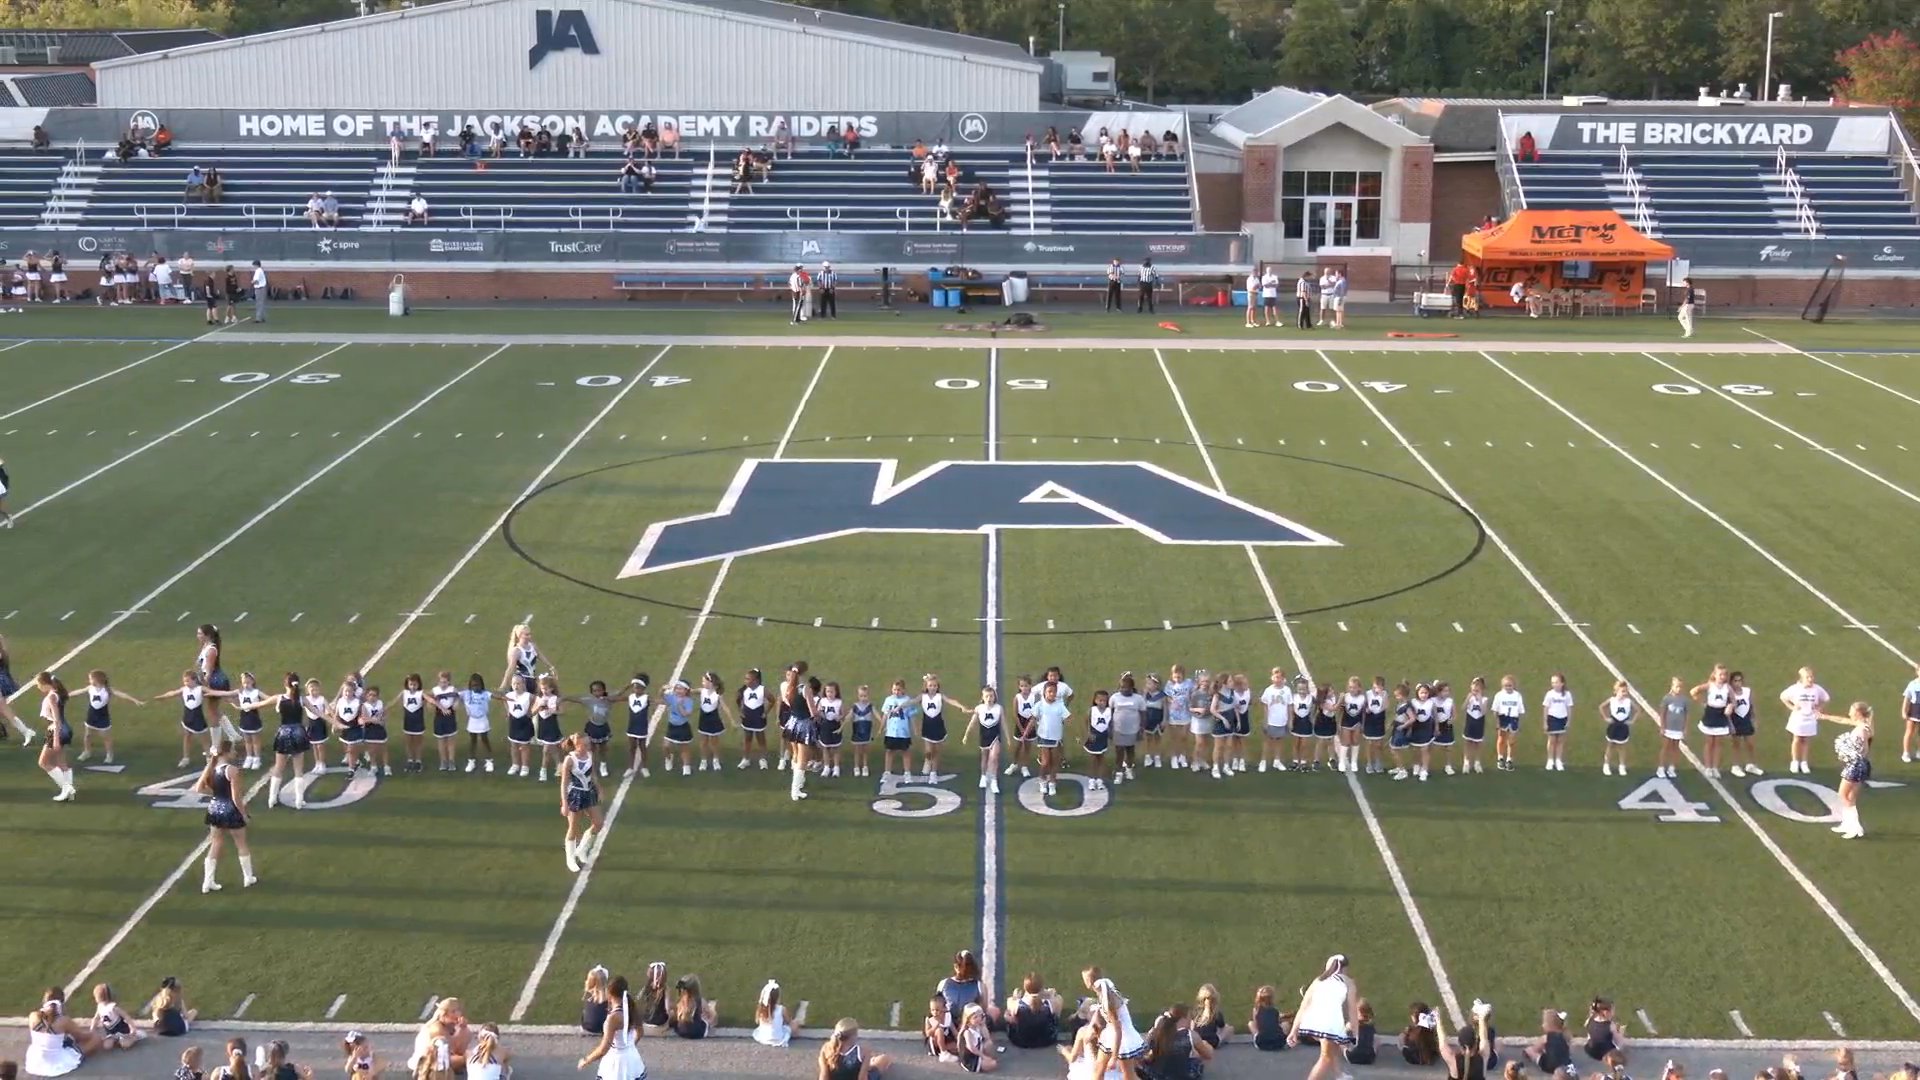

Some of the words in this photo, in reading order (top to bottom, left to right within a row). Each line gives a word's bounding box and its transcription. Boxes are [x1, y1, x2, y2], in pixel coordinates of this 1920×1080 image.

[529, 9, 601, 71] JA
[239, 115, 326, 136] HOME
[333, 115, 374, 136] OF
[380, 115, 439, 137] THE
[447, 115, 586, 137] JACKSON
[593, 115, 741, 137] ACADEMY
[964, 118, 984, 135] JA
[1577, 122, 1636, 144] THE
[1644, 122, 1813, 145] BRICKYARD
[549, 241, 601, 252] TrustCare
[802, 240, 821, 256] JA
[615, 457, 1344, 579] JA
